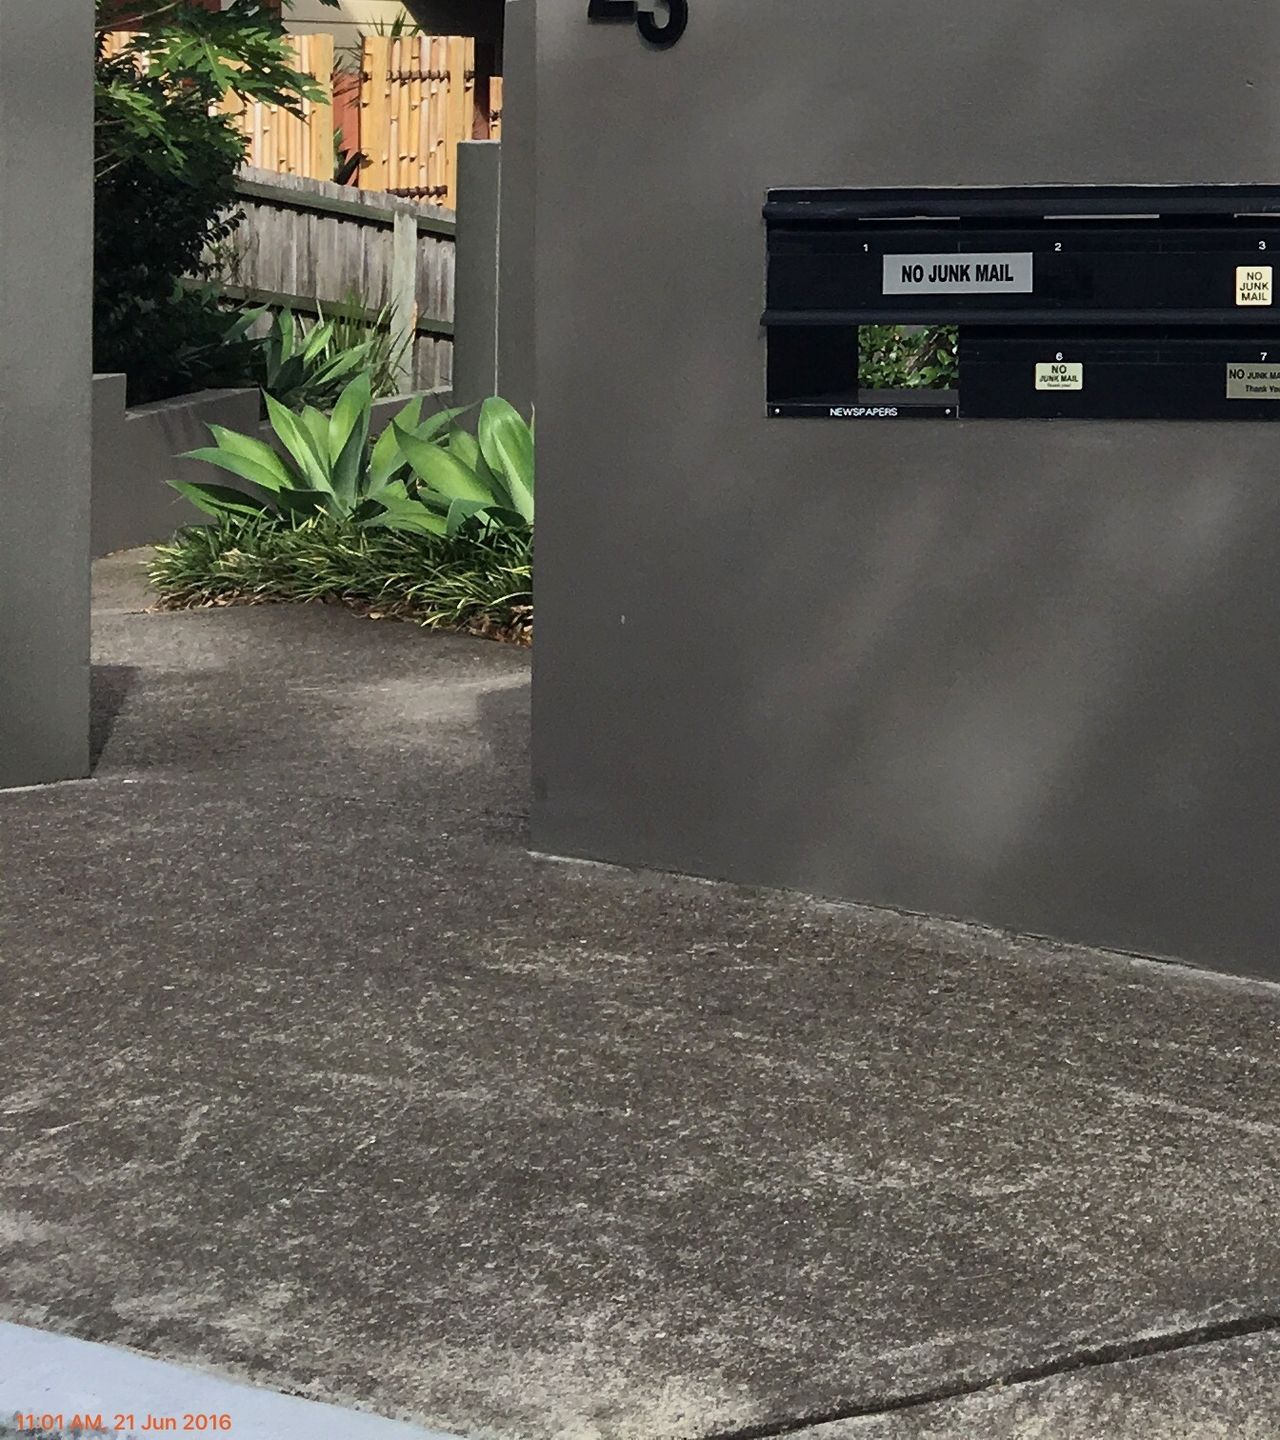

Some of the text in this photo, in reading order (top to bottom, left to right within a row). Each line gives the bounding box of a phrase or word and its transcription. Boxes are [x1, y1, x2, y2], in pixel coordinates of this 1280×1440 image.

[863, 243, 869, 252] 1
[1054, 242, 1062, 252] 2
[1258, 240, 1267, 250] 3
[901, 263, 1014, 283] NO JUNK MAIL
[1246, 271, 1263, 281] NO
[1240, 282, 1269, 291] JUNK
[1241, 292, 1268, 301] MAIL
[1055, 352, 1063, 361] 6
[1260, 351, 1268, 361] 7
[1051, 364, 1067, 374] NO
[1229, 369, 1245, 380] NO
[1247, 372, 1268, 380] JUNK
[829, 408, 898, 417] NEWSPAPERS
